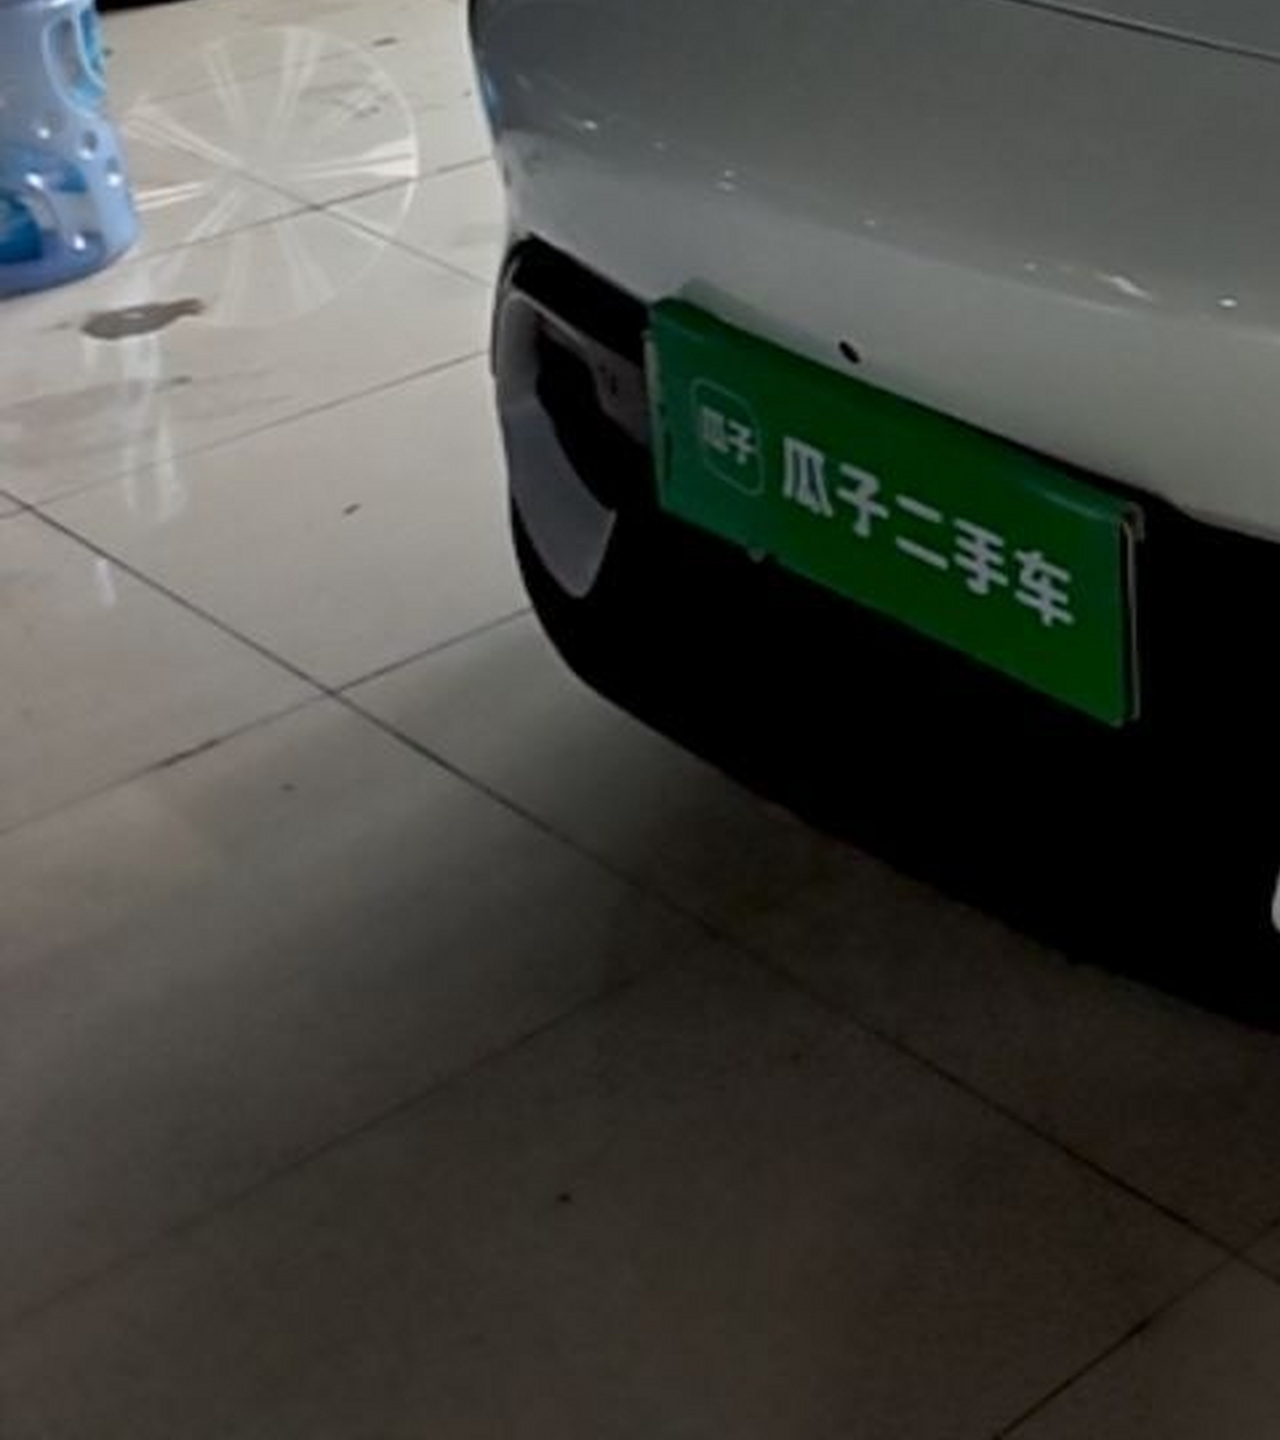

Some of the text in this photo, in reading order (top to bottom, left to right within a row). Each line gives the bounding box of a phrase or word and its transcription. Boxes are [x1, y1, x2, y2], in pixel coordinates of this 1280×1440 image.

[701, 404, 757, 465] 瓜子
[782, 435, 1076, 628] 瓜子二手车
